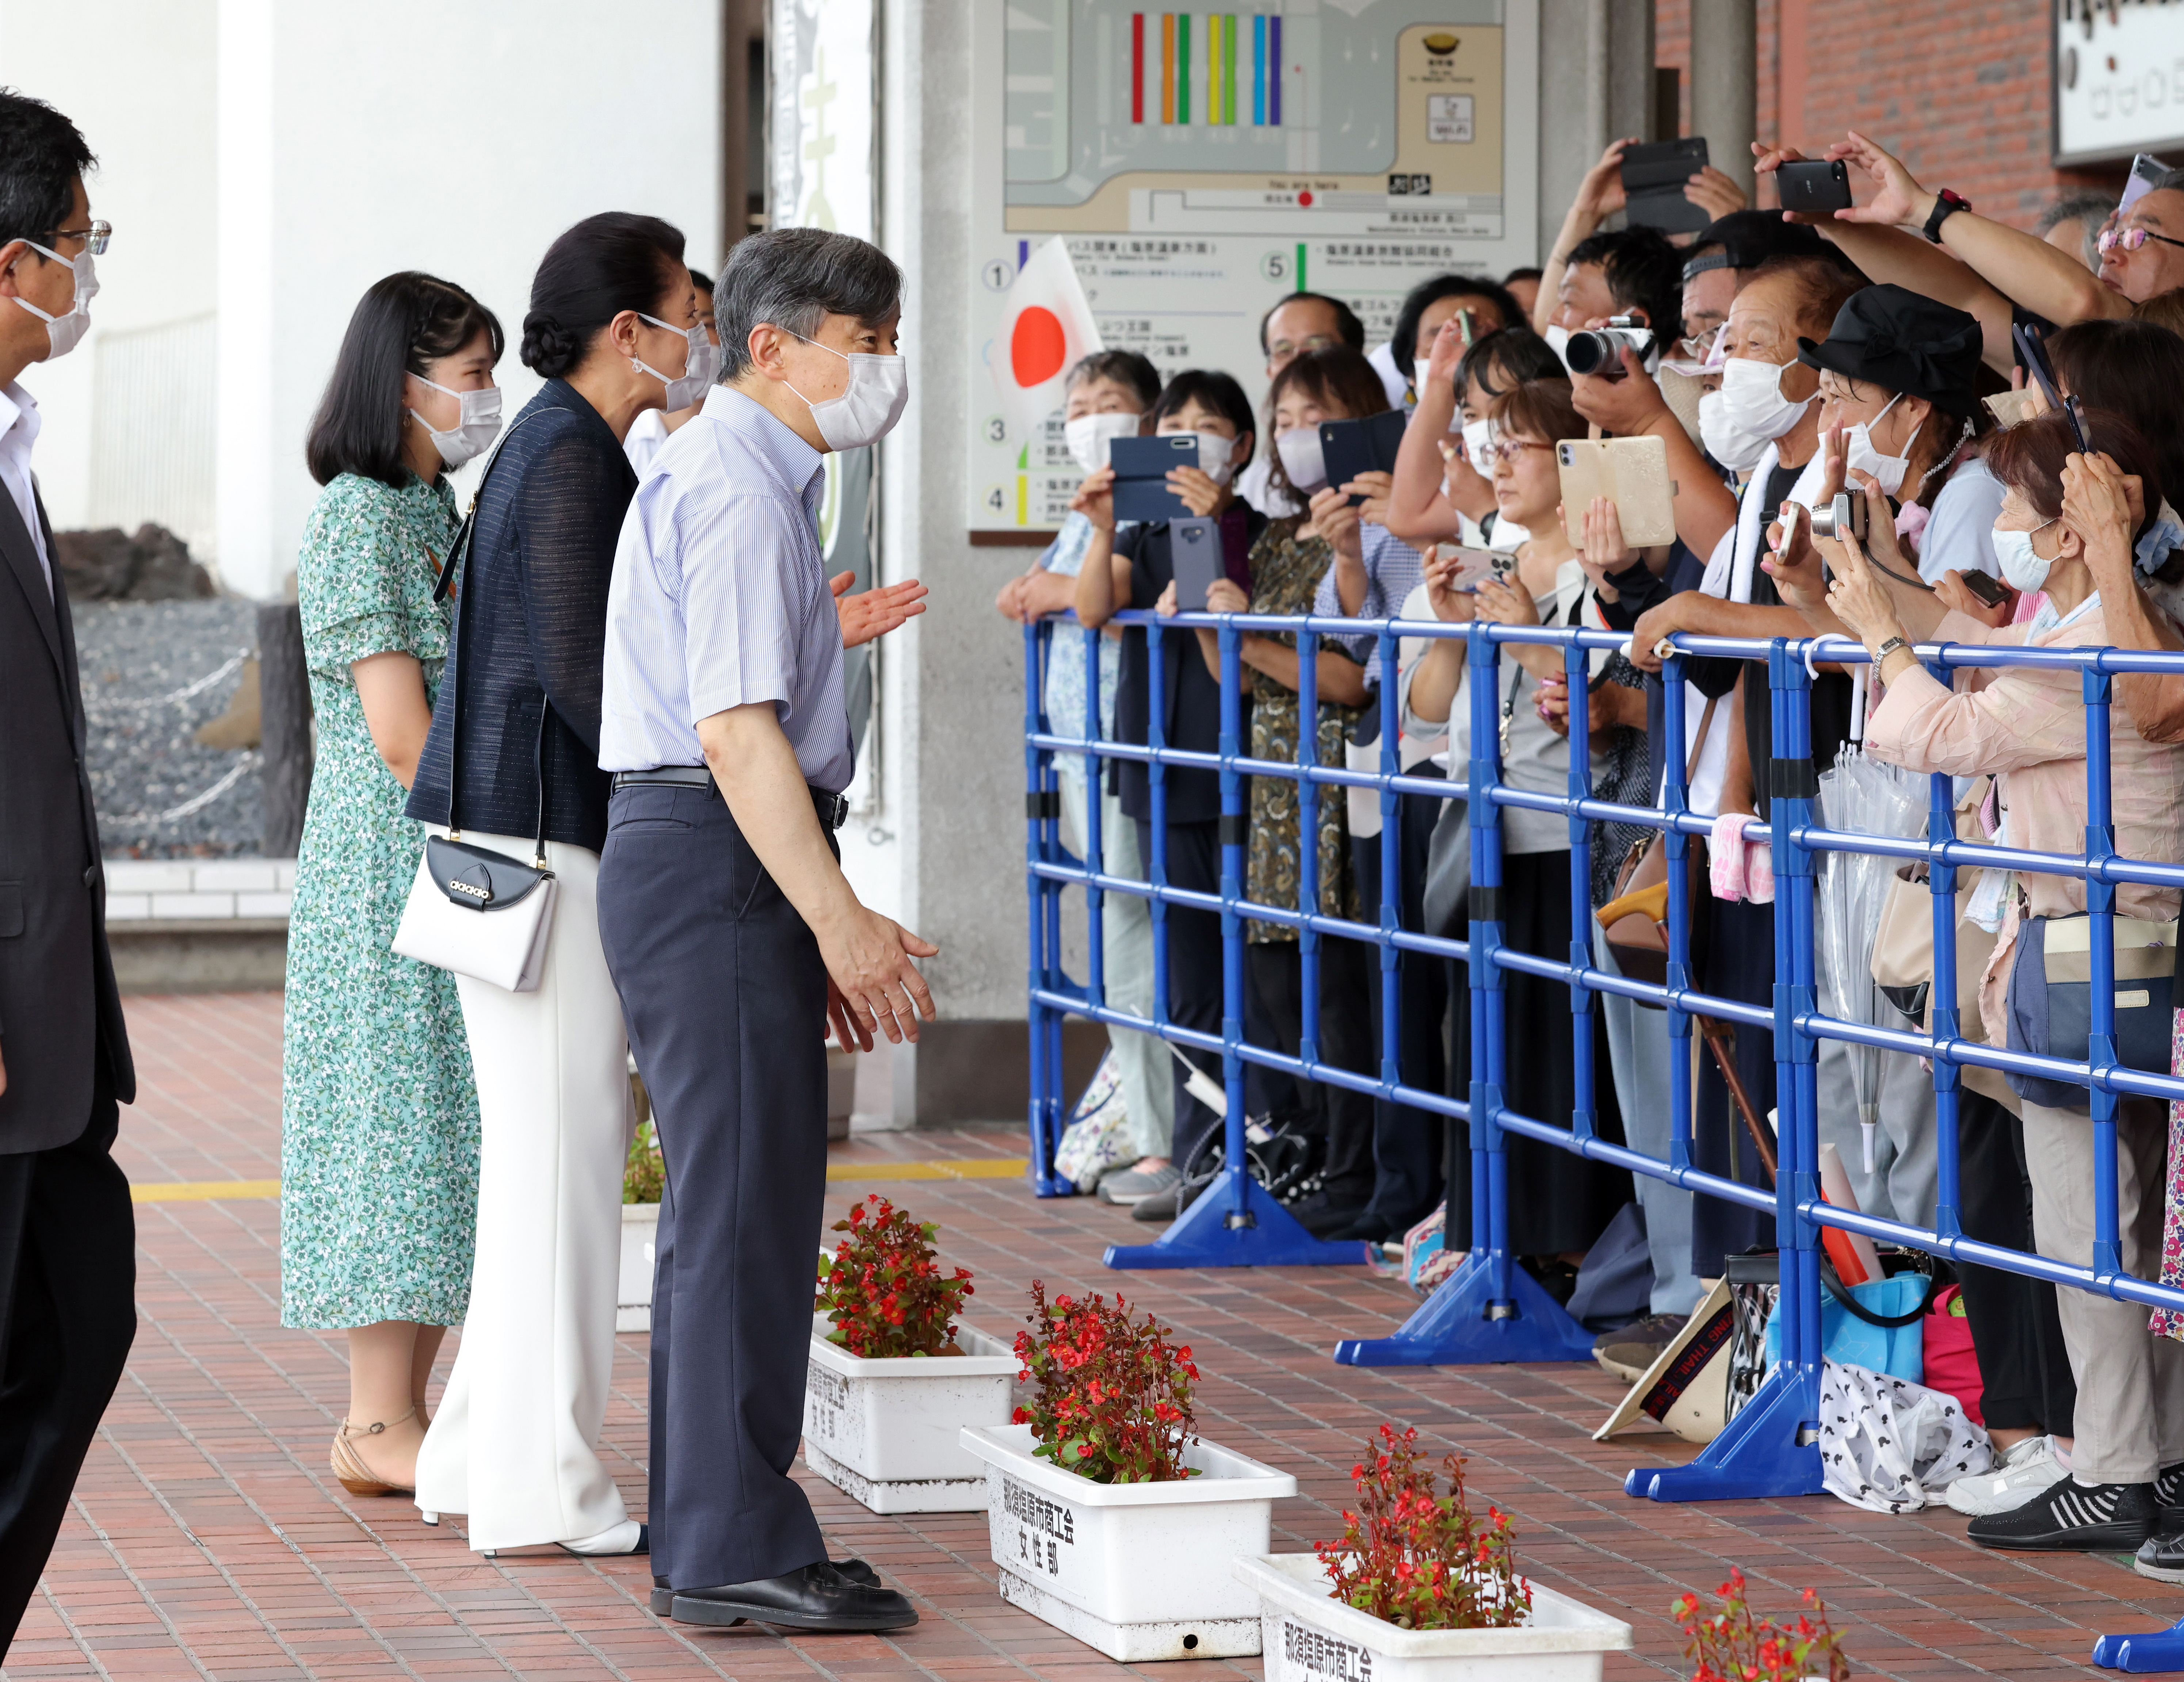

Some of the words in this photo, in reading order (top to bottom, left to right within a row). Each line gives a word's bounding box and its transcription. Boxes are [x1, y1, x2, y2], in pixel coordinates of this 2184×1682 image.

[992, 267, 1002, 286] 1
[1269, 256, 1284, 278] 5
[991, 419, 1005, 441] 3
[989, 488, 1003, 511] 4
[1674, 1344, 1710, 1377] THAIL
[2014, 1474, 2030, 1485] PUMA
[1003, 1478, 1074, 1546] 那須塩原市商工会
[1019, 1525, 1058, 1577] 女性部
[1284, 1621, 1372, 1682] 那須塩原市商工会
